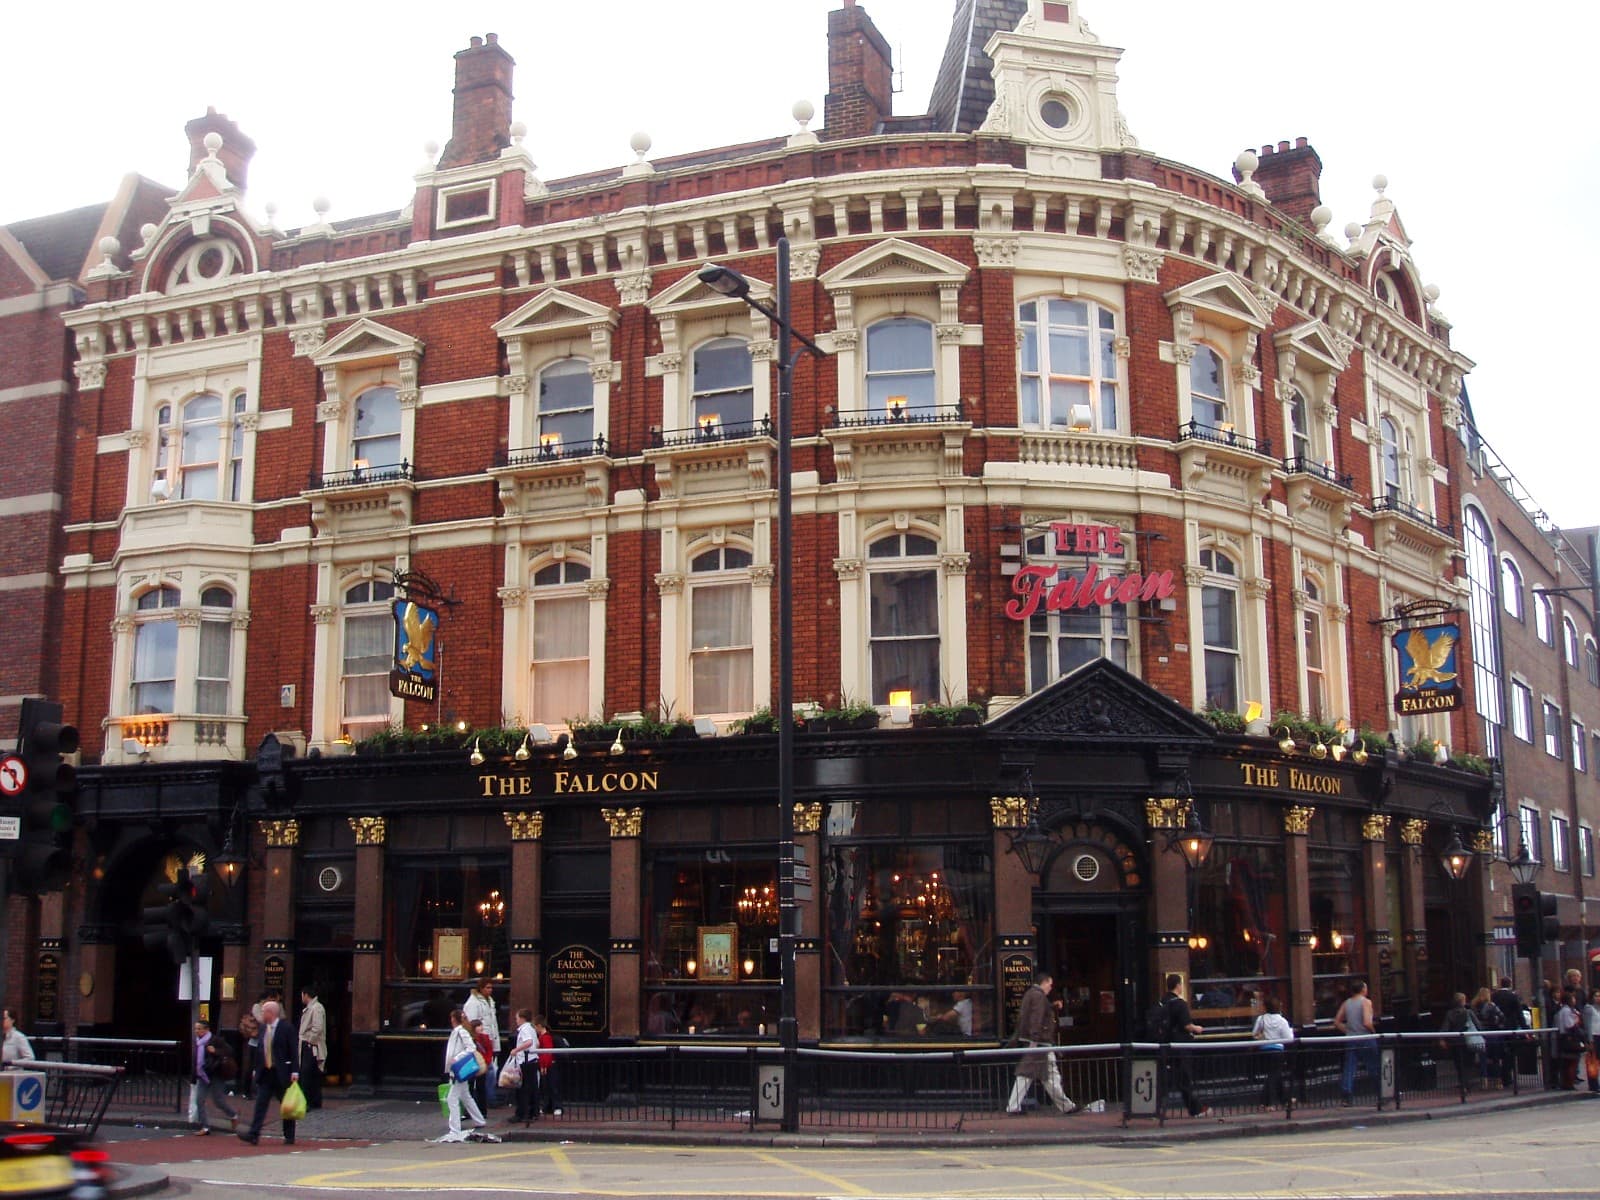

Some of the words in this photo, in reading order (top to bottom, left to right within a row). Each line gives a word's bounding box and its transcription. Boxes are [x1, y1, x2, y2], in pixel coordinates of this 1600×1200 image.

[1051, 523, 1124, 553] THE
[1005, 563, 1176, 620] Falcon
[411, 674, 422, 682] THE
[398, 679, 434, 700] FALCON
[1401, 695, 1454, 712] FALCON
[478, 775, 532, 796] THE
[554, 771, 658, 793] FALCON
[1240, 763, 1279, 787] THE
[1289, 768, 1341, 794] FALCON
[557, 959, 595, 969] FALCON
[568, 951, 585, 959] THE
